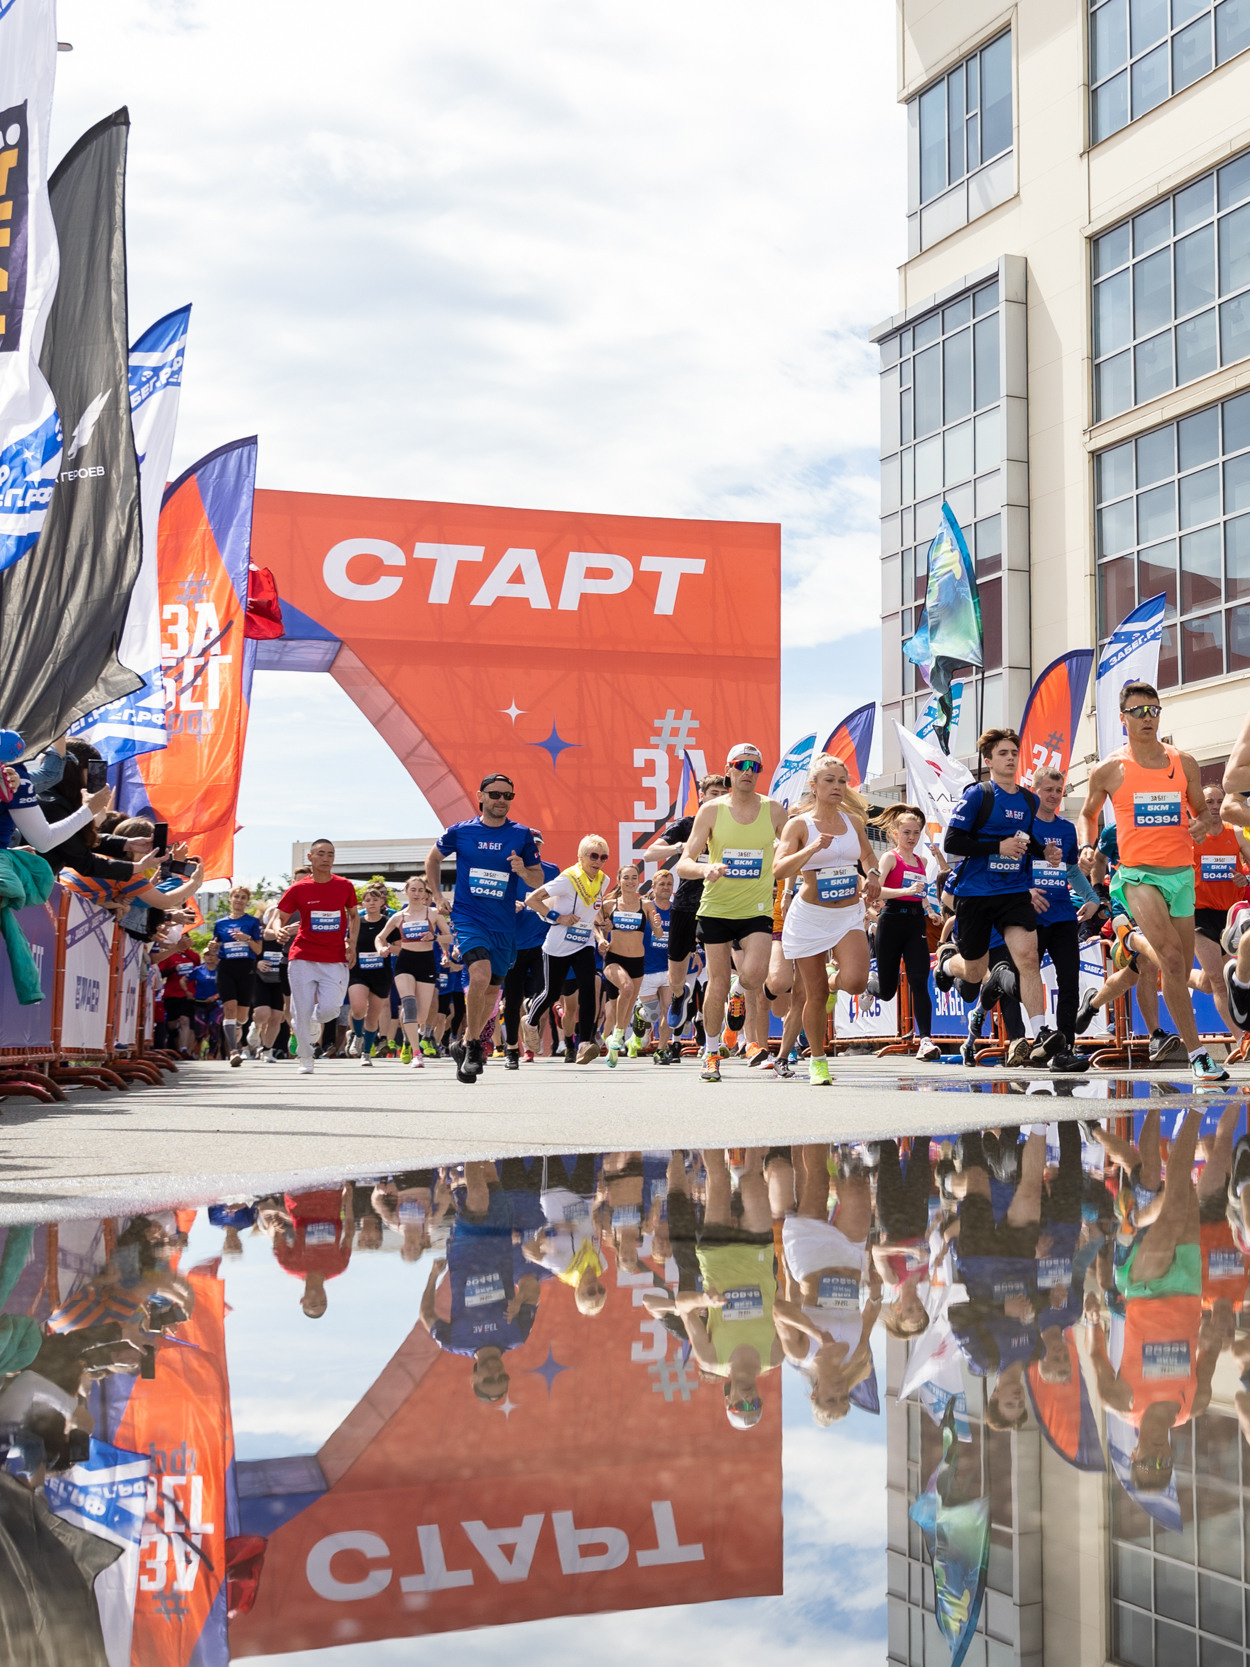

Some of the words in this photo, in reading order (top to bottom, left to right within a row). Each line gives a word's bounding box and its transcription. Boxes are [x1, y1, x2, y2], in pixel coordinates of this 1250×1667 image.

[322, 537, 706, 616] СТАРТ
[162, 602, 222, 659] ЗА
[1137, 815, 1179, 824] 50394
[990, 862, 1020, 870] 50032
[725, 868, 760, 876] 50848
[1034, 879, 1065, 887] 50240
[470, 886, 503, 897] 50448
[821, 887, 856, 899] 50226
